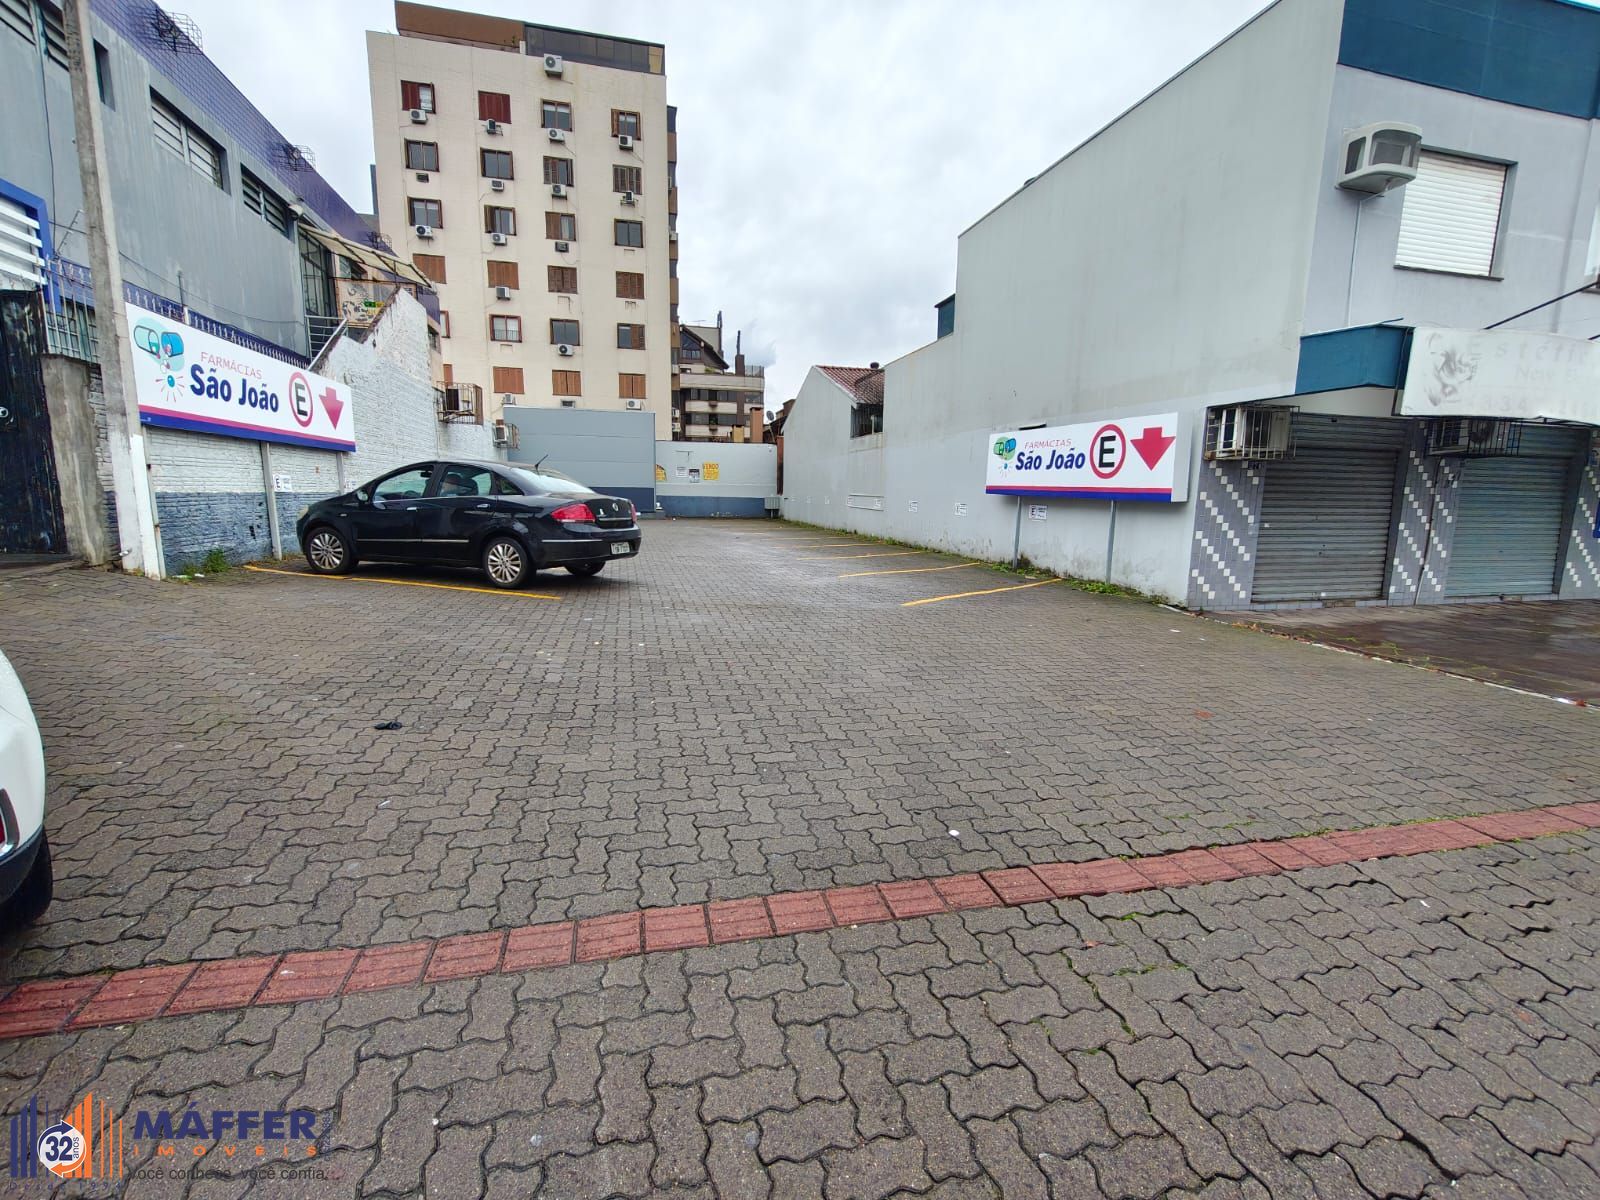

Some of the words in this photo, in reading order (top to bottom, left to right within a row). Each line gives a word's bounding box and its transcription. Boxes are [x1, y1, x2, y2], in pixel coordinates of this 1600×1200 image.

[200, 351, 263, 380] FARMÁCIAS
[190, 363, 232, 402] São
[238, 378, 280, 413] João
[294, 382, 308, 417] E
[1015, 450, 1042, 471] São
[1045, 447, 1086, 471] João
[1098, 435, 1116, 468] E
